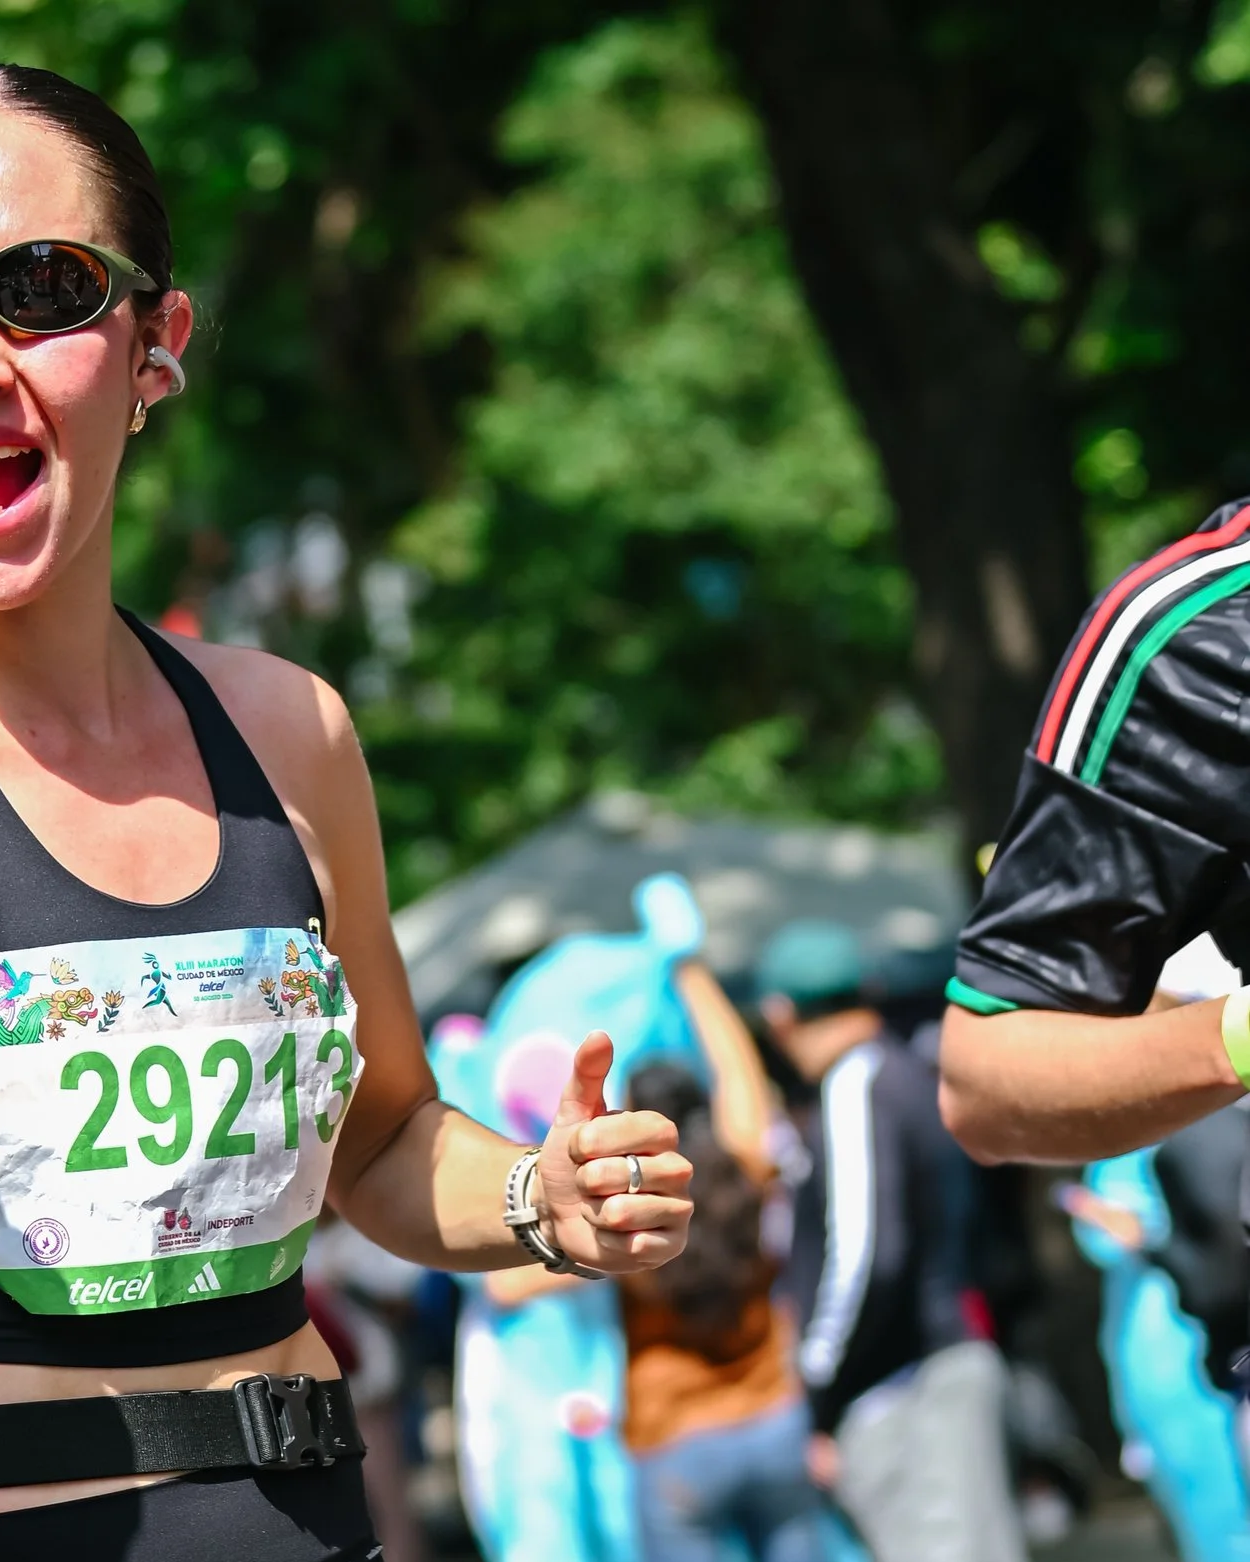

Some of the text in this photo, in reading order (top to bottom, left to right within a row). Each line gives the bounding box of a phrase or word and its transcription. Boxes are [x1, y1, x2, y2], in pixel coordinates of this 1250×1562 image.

[175, 960, 195, 971] XLIII
[177, 967, 245, 980] CIUDAD DE MÉXICO
[199, 980, 226, 992] telcel
[60, 1028, 353, 1173] 29213
[207, 1216, 255, 1230] INDEPORTE
[158, 1233, 183, 1242] GOBIERNO
[158, 1240, 174, 1248] CIUDAD
[69, 1271, 155, 1305] telcel
